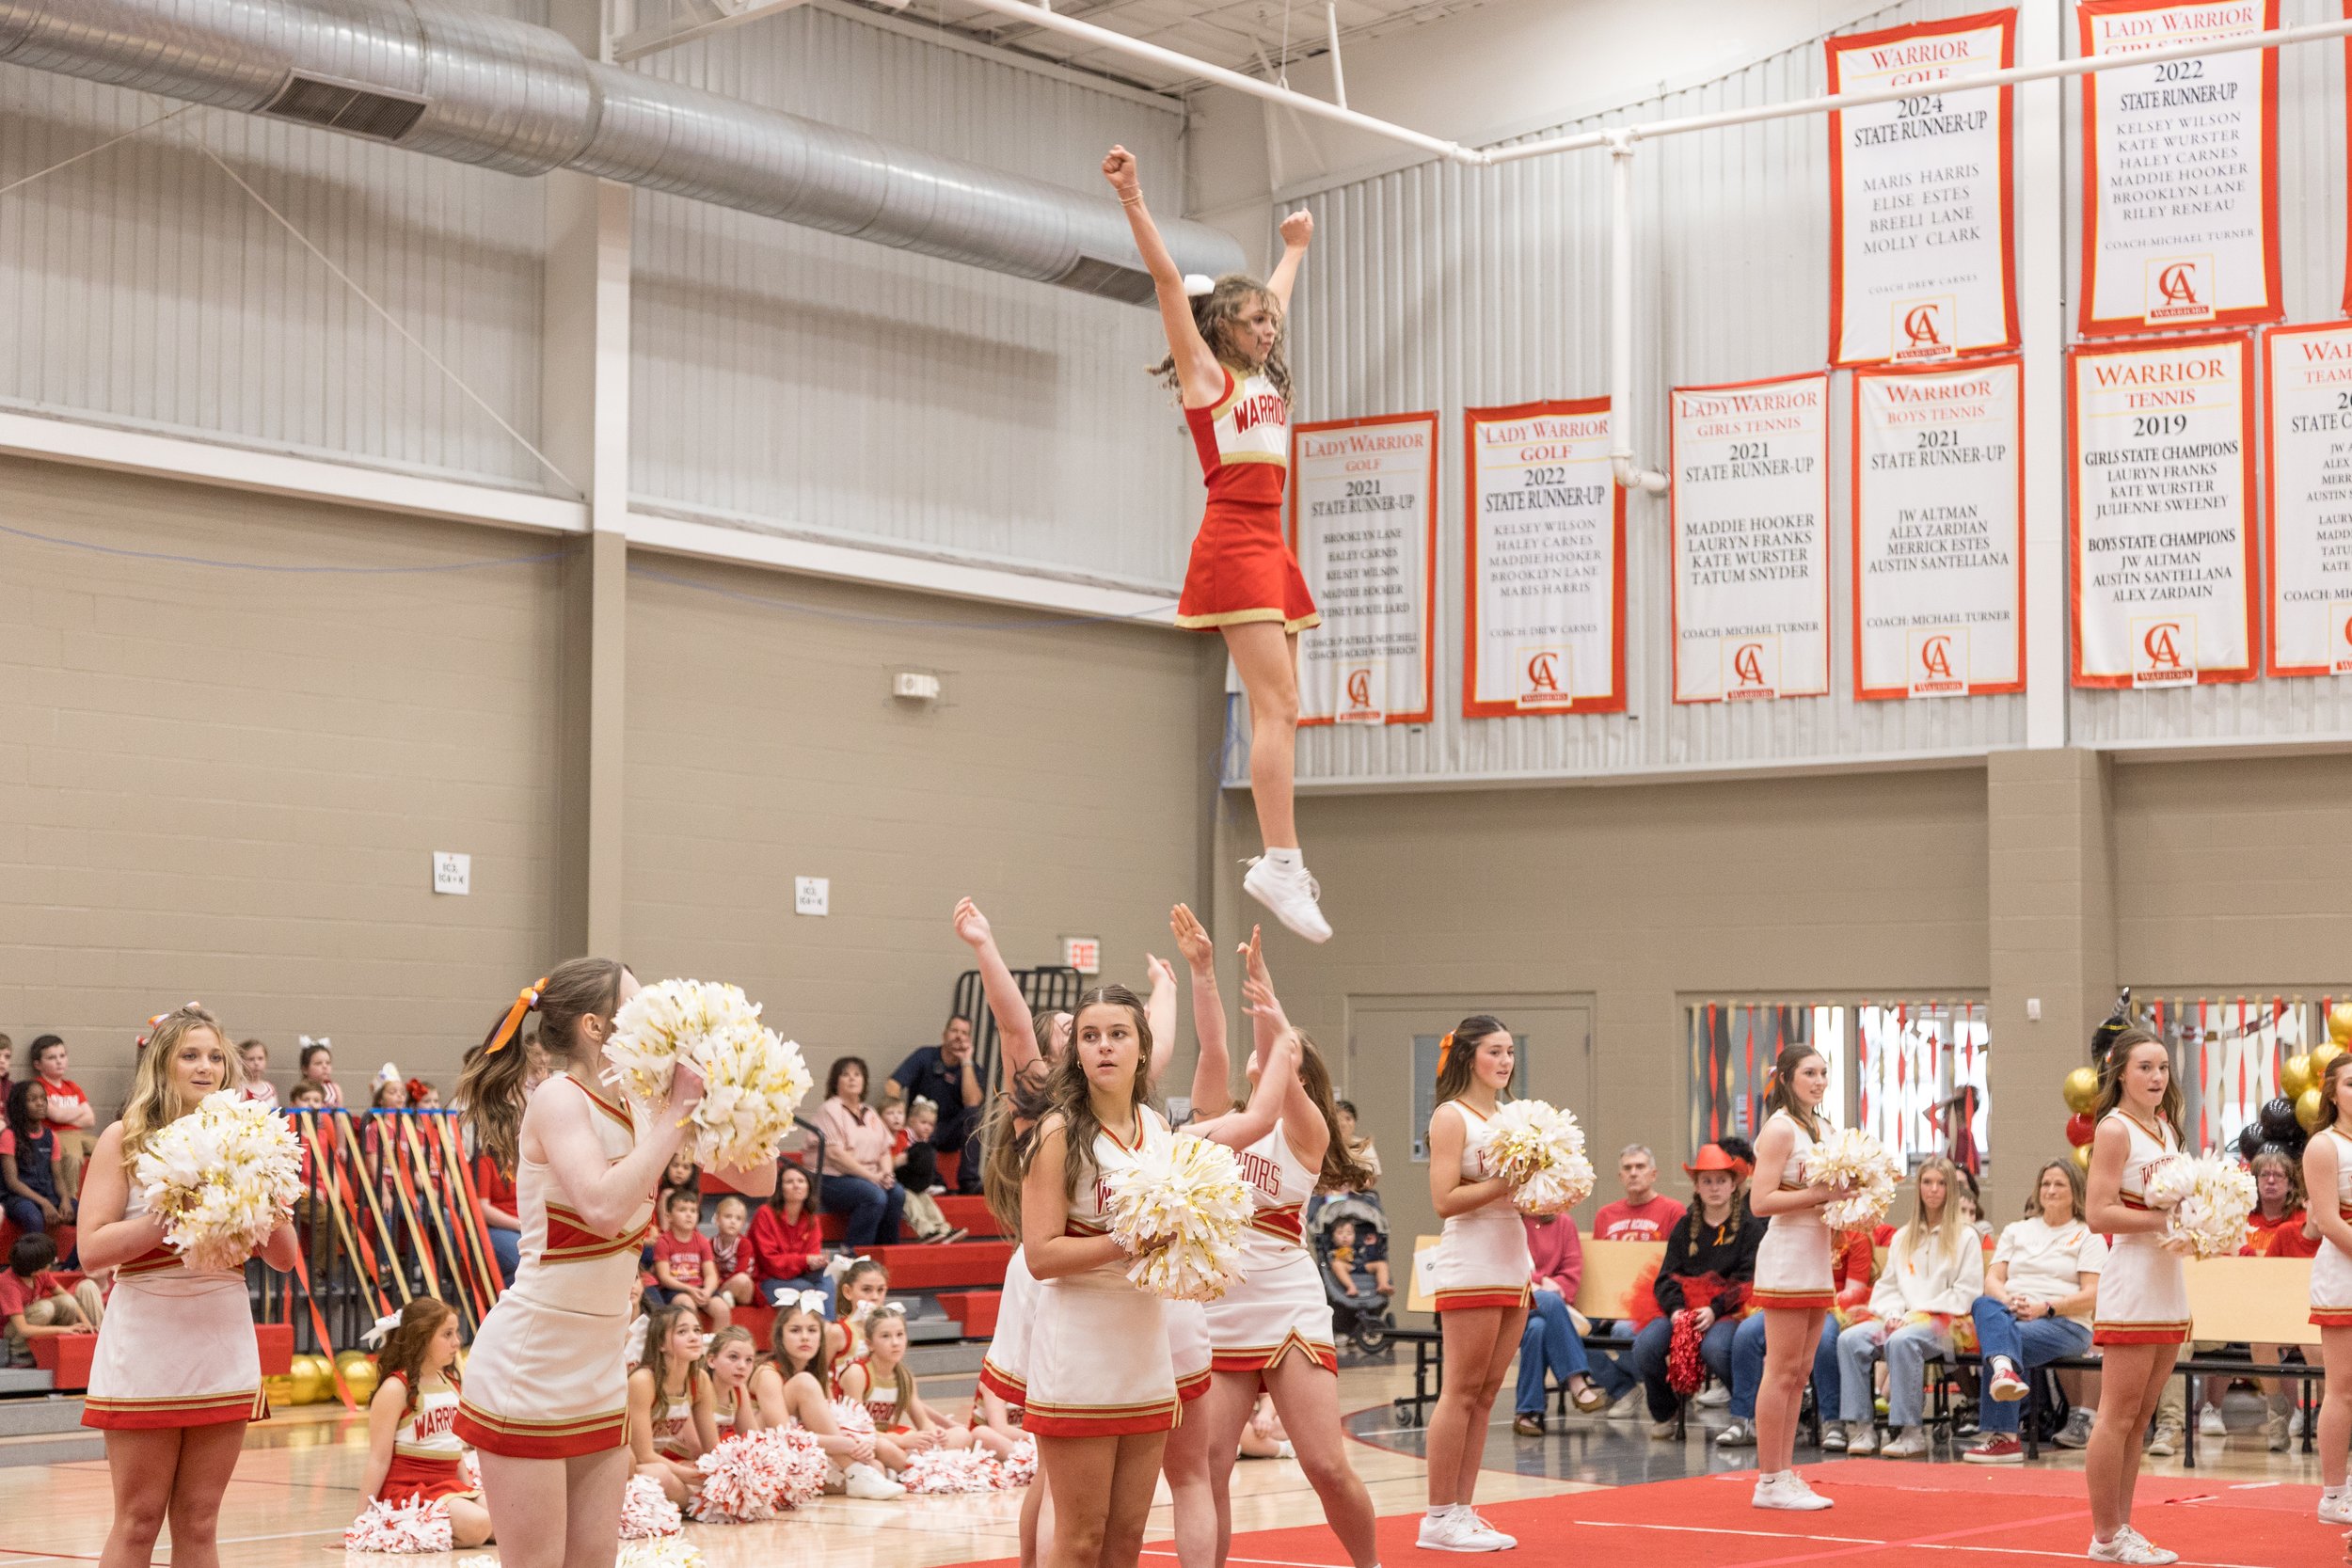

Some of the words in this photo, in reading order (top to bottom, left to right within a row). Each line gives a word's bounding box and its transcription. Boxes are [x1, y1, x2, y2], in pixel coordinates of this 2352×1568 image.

[2105, 18, 2156, 39] LADY
[2162, 7, 2254, 31] WARRIOR
[1871, 40, 1969, 70] WARRIOR
[2154, 60, 2204, 83] 2022
[1897, 94, 1944, 119] 2024
[2121, 90, 2160, 112] STATE
[2163, 82, 2238, 107] RUNNER-UP
[1854, 123, 1899, 148] STATE
[1901, 110, 1987, 140] RUNNER-UP
[2117, 119, 2173, 136] KELSEY
[2179, 111, 2242, 129] WILSON
[2118, 137, 2160, 153] KATE
[2164, 130, 2240, 149] WURSTER
[2120, 154, 2169, 170] HALEY
[2176, 147, 2238, 164] CARNES
[1863, 173, 1912, 192] MARIS
[1920, 163, 1979, 184] HARRIS
[2111, 171, 2174, 188] MADDIE
[2179, 163, 2249, 182] HOOKER
[1873, 193, 1915, 212] ELISE
[1922, 186, 1970, 205] ESTES
[2113, 186, 2200, 204] BROOKLYN
[2204, 180, 2246, 195] LANE
[1931, 206, 1974, 225] LANE
[2123, 205, 2167, 221] RILEY
[2171, 198, 2235, 216] RENEAU
[1863, 235, 1918, 255] MOLLY
[1926, 226, 1980, 245] CLARK
[2151, 233, 2202, 246] MICHAEL
[2209, 228, 2254, 241] TURNER
[2095, 358, 2225, 388] WARRIOR
[1884, 381, 1992, 404] WARRIOR
[2124, 388, 2196, 408] TENNIS
[1681, 399, 1731, 419] LADY
[1733, 390, 1818, 412] WARRIOR
[1887, 409, 1926, 424] BOYS
[1931, 404, 1985, 421] TENNIS
[1486, 425, 1529, 445] LADY
[1533, 420, 1609, 438] WARRIOR
[1697, 423, 1741, 437] GIRLS
[1747, 416, 1802, 434] TENNIS
[2134, 414, 2187, 436] 2019
[2292, 413, 2340, 434] STATE
[1304, 439, 1348, 458] LADY
[1349, 434, 1423, 452] WARRIOR
[1917, 430, 1959, 449] 2021
[1520, 444, 1573, 462] GOLF
[1729, 442, 1769, 461] 2021
[1871, 451, 1916, 470] STATE
[1920, 444, 2006, 466] RUNNER-UP
[2085, 451, 2119, 467] GIRLS
[2122, 447, 2159, 463] STATE
[2162, 440, 2239, 461] CHAMPIONS
[1345, 458, 1382, 472] GOLF
[1686, 464, 1729, 483] STATE
[1732, 456, 1815, 479] RUNNER-UP
[2107, 467, 2160, 483] LAURYN
[2164, 462, 2217, 478] FRANKS
[2323, 457, 2350, 470] ALEX
[1524, 467, 1565, 487] 2022
[1345, 480, 1381, 497] 2021
[1486, 491, 1525, 513] STATE
[1528, 485, 1606, 510] RUNNER-UP
[2111, 485, 2144, 499] KATE
[2147, 480, 2215, 496] WURSTER
[2307, 490, 2347, 502] AUSTIN
[1311, 499, 1346, 516] STATE
[1899, 510, 1916, 524] JW
[1920, 504, 1978, 521] ALTMAN
[2096, 501, 2163, 519] JULIENNE
[2165, 495, 2229, 512] SWEENEY
[1494, 522, 1541, 536] KELSEY
[1544, 518, 1597, 532] WILSON
[1686, 519, 1747, 536] MADDIE
[1750, 514, 1815, 531] HOOKER
[1889, 525, 1923, 540] ALEX
[1926, 520, 1988, 538] ZARDIAN
[1496, 538, 1540, 551] HALEY
[1543, 534, 1594, 548] CARNES
[1688, 535, 1749, 552] LAURYN
[1753, 531, 1813, 547] FRANKS
[1887, 541, 1947, 556] MERRICK
[1951, 537, 1990, 551] ESTES
[2089, 538, 2117, 553] BOYS
[2119, 534, 2156, 549] STATE
[2160, 529, 2236, 547] CHAMPIONS
[1489, 554, 1542, 567] MADDIE
[1543, 549, 1602, 564] HOOKER
[1692, 553, 1732, 569] KATE
[1735, 547, 1808, 565] WURSTER
[1868, 558, 1918, 574] AUSTIN
[1921, 552, 2010, 570] SANTELLANA
[2122, 555, 2141, 570] JW
[2145, 551, 2201, 567] ALTMAN
[2322, 561, 2351, 573] KATE
[1490, 569, 1563, 582] BROOKLYN
[1692, 570, 1746, 585] TATUM
[1750, 565, 1809, 581] SNYDER
[2093, 572, 2140, 588] AUSTIN
[2144, 566, 2233, 584] SANTELLANA
[1500, 585, 1540, 597] MARIS
[1541, 582, 1591, 594] HARRIS
[2114, 589, 2146, 603] ALEX
[2151, 585, 2214, 600] ZARDAIN
[1725, 624, 1772, 636] MICHAEL
[1776, 621, 1820, 633] TURNER
[1912, 613, 1962, 626] MICHAEL
[1965, 610, 2010, 623] TURNER
